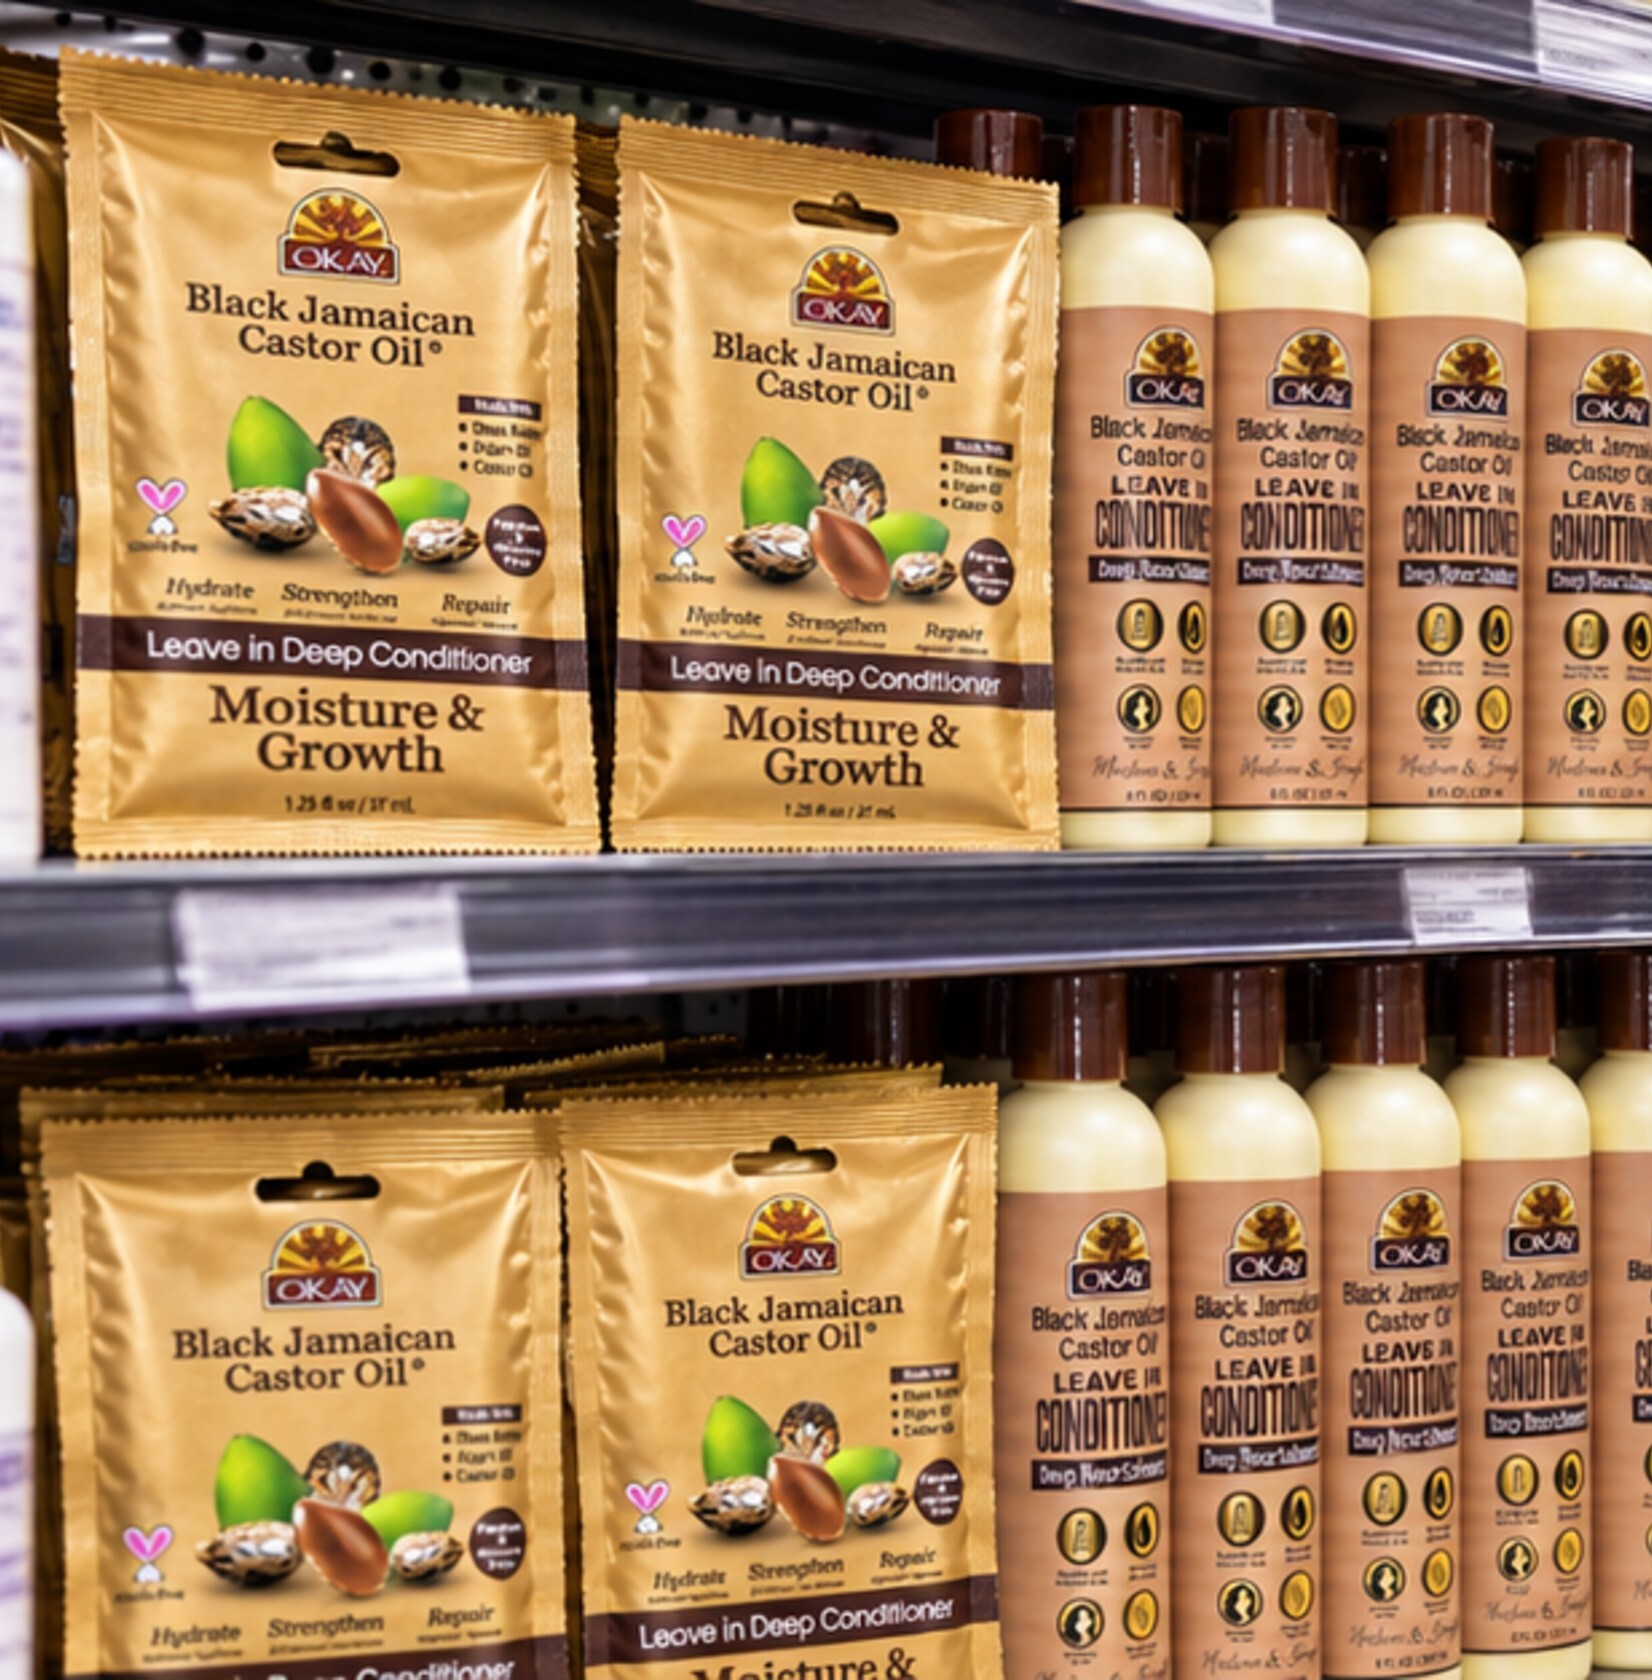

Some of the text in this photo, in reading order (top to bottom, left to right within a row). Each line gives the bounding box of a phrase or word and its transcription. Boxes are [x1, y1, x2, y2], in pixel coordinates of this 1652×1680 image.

[291, 246, 386, 275] OKAY
[186, 281, 475, 336] Black Jamaican
[803, 298, 885, 326] OKAY
[238, 325, 362, 363] Castor
[712, 331, 957, 383] Black Jamaican
[756, 370, 859, 407] Castor
[1255, 477, 1335, 499] LEAVE
[1416, 481, 1492, 503] LEAVE
[1562, 490, 1636, 512] LEAVE
[146, 631, 533, 674] Leave in Deep Conditioner
[670, 656, 751, 683] Leave
[758, 658, 781, 684] in
[786, 661, 854, 693] Deep
[208, 685, 485, 731] Moisture &
[723, 704, 960, 749] Moisture &
[257, 731, 445, 773] Growth
[764, 747, 924, 788] Growth
[751, 1248, 829, 1274] OKAY
[276, 1276, 369, 1301] OKAY
[664, 1290, 904, 1328] Black Jamaican
[172, 1323, 456, 1360] Black Jamaican
[709, 1330, 811, 1359] Castor
[1498, 1325, 1566, 1348] LEAVE
[224, 1363, 345, 1394] Castor
[1053, 1369, 1138, 1395] LEAVE
[1215, 1356, 1294, 1381] LEAVE
[722, 1616, 745, 1642] in
[750, 1613, 816, 1641] Deep
